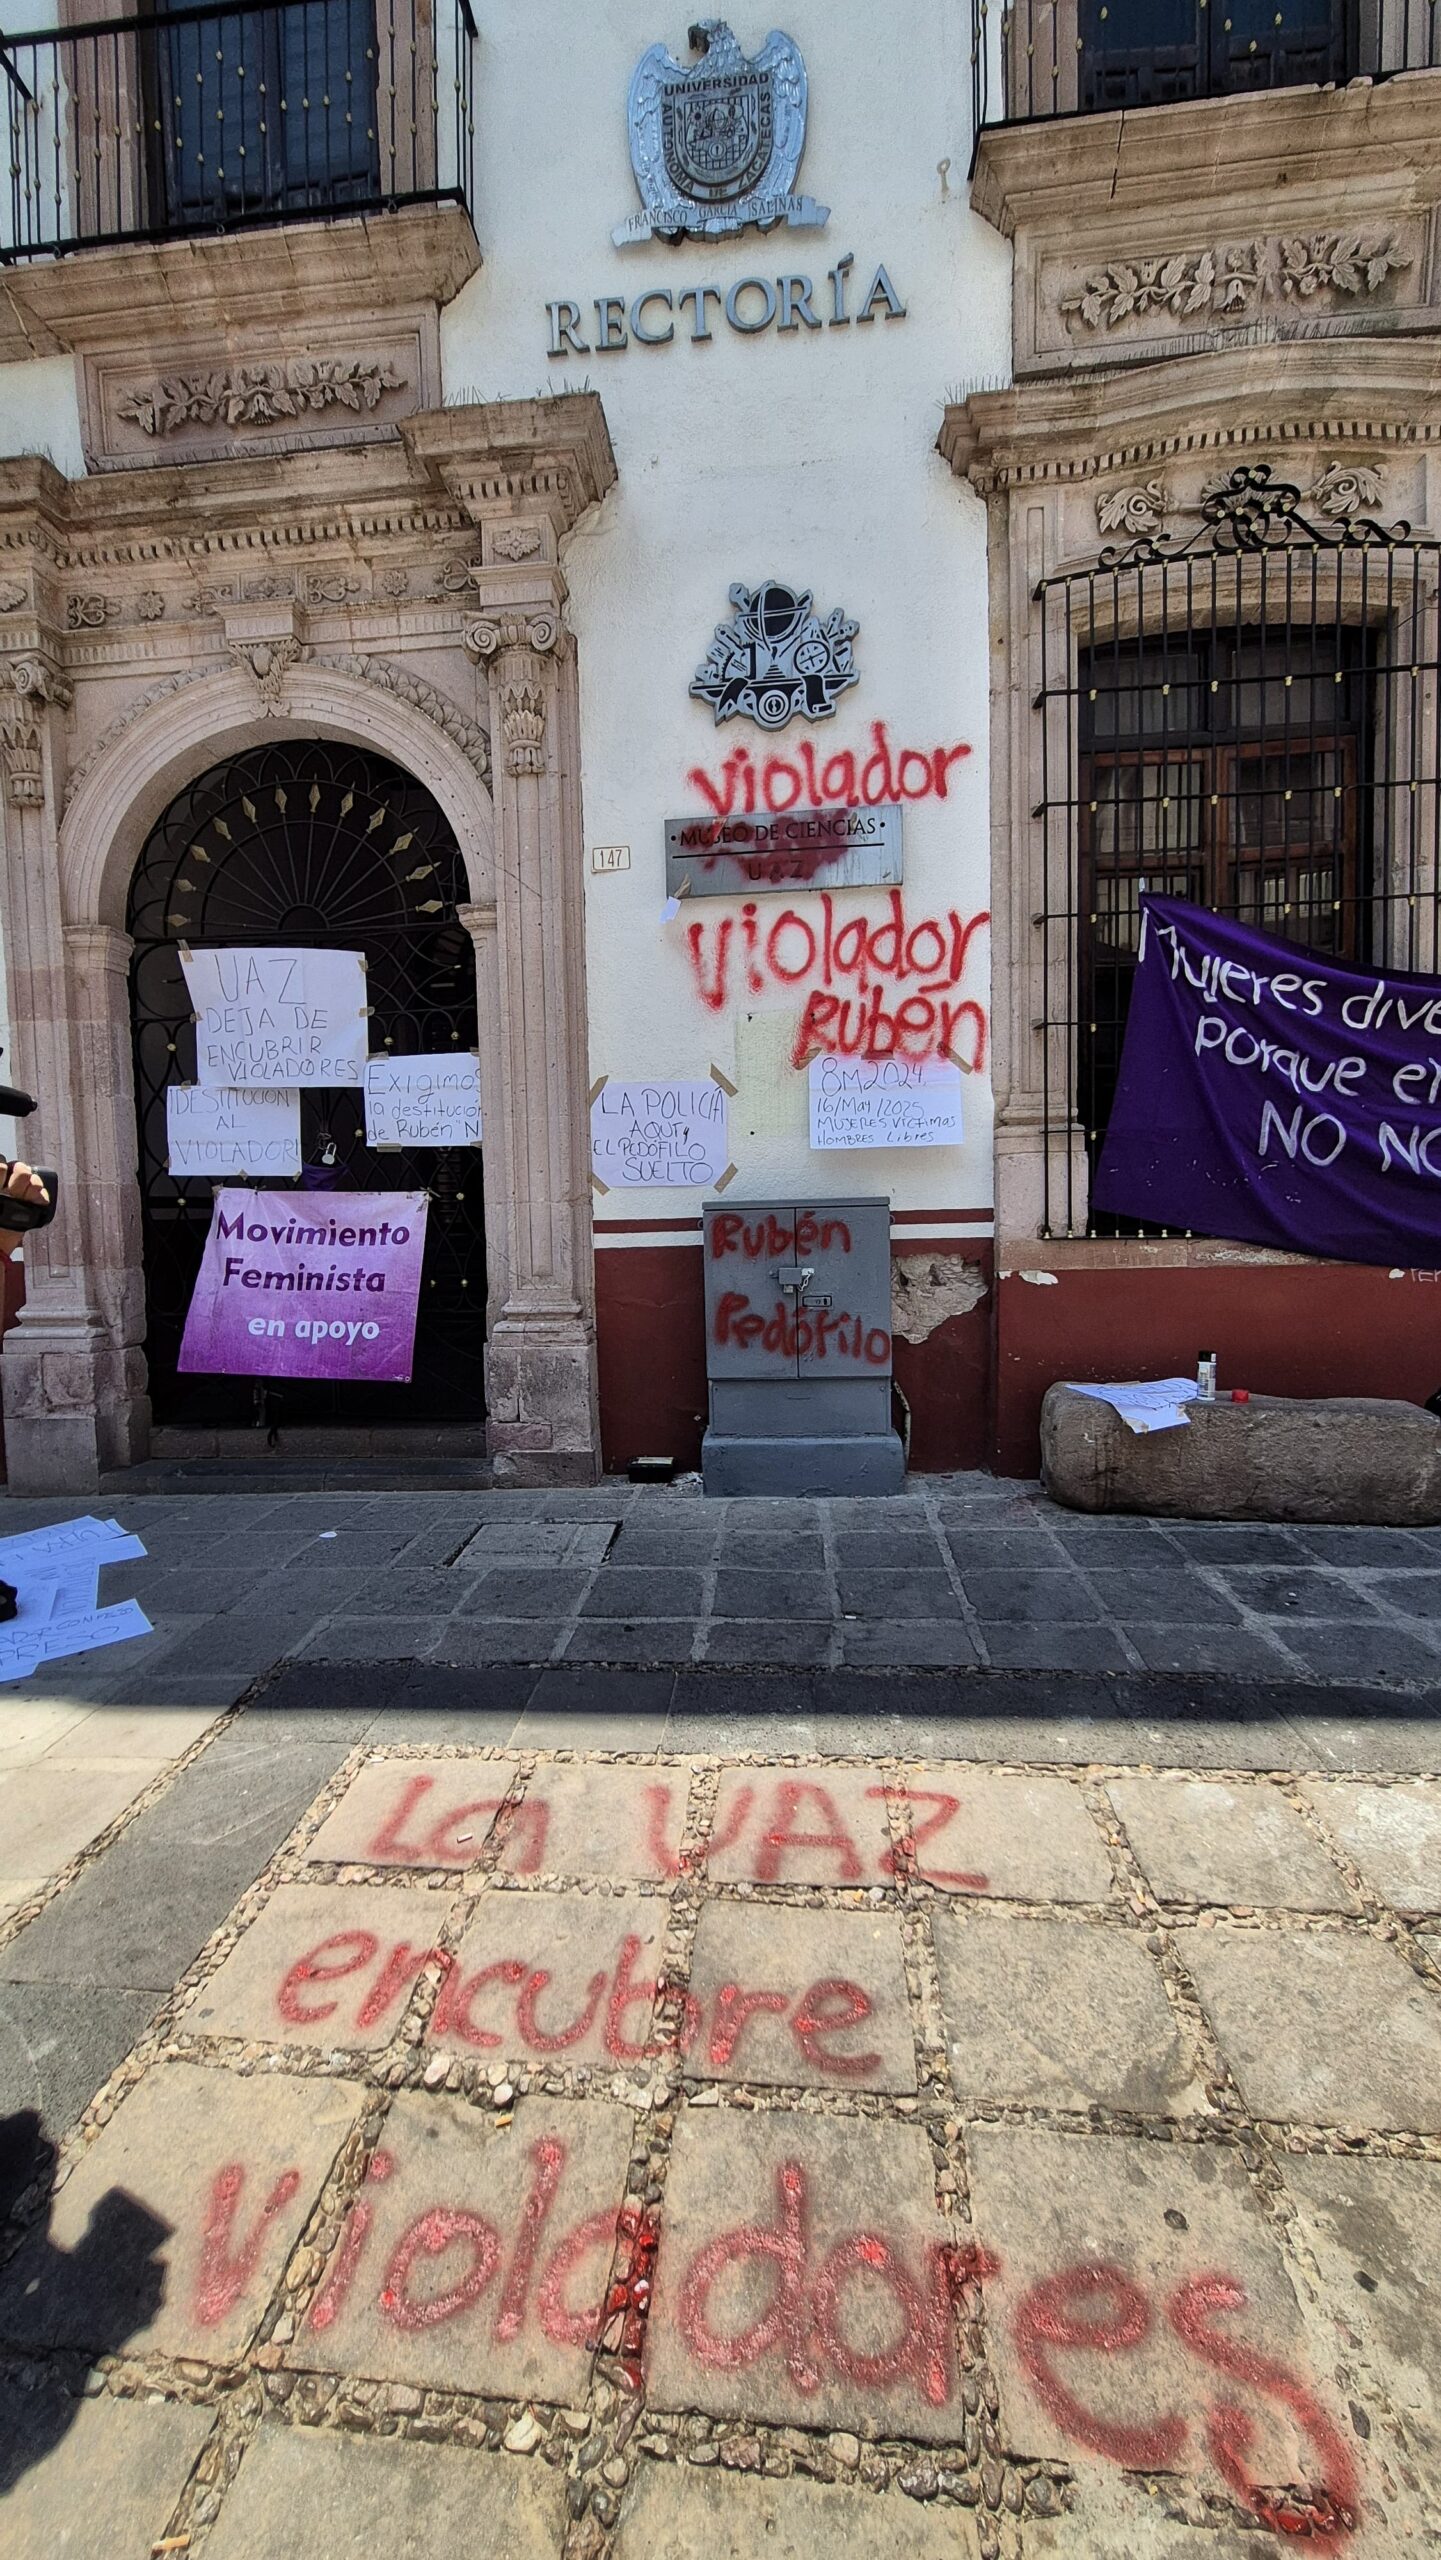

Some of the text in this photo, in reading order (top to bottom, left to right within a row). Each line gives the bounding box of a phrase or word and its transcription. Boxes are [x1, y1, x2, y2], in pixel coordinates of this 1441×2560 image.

[663, 72, 770, 97] UNIVERSIDAD
[737, 90, 772, 190] ZACATECAS
[628, 208, 688, 233] FRANCISCO
[751, 196, 803, 217] SALINAS
[545, 252, 907, 358] RECTORÍA
[754, 824, 779, 842] DE
[785, 817, 876, 840] CIENCIAS
[600, 849, 623, 868] 147
[214, 954, 307, 1005] UAZ
[205, 1006, 329, 1036] DEJA DE
[207, 1035, 323, 1068] ENCUBRIR
[227, 1058, 360, 1083] VIOLADORES
[601, 1091, 636, 1117] LA
[216, 1113, 249, 1131] AL
[366, 1119, 390, 1141] de
[396, 1118, 453, 1139] Rubén
[816, 1115, 887, 1132] MUJERES
[1257, 1099, 1347, 1167] NO
[593, 1138, 616, 1156] EL
[816, 1129, 875, 1146] HOMBRES
[622, 1156, 714, 1184] SUELTO
[215, 1209, 411, 1247] Movimiento
[222, 1256, 387, 1293] Feminista
[247, 1317, 381, 1346] en apoyo
[642, 1780, 989, 1891] UAZ
[275, 1928, 886, 2077] encubre
